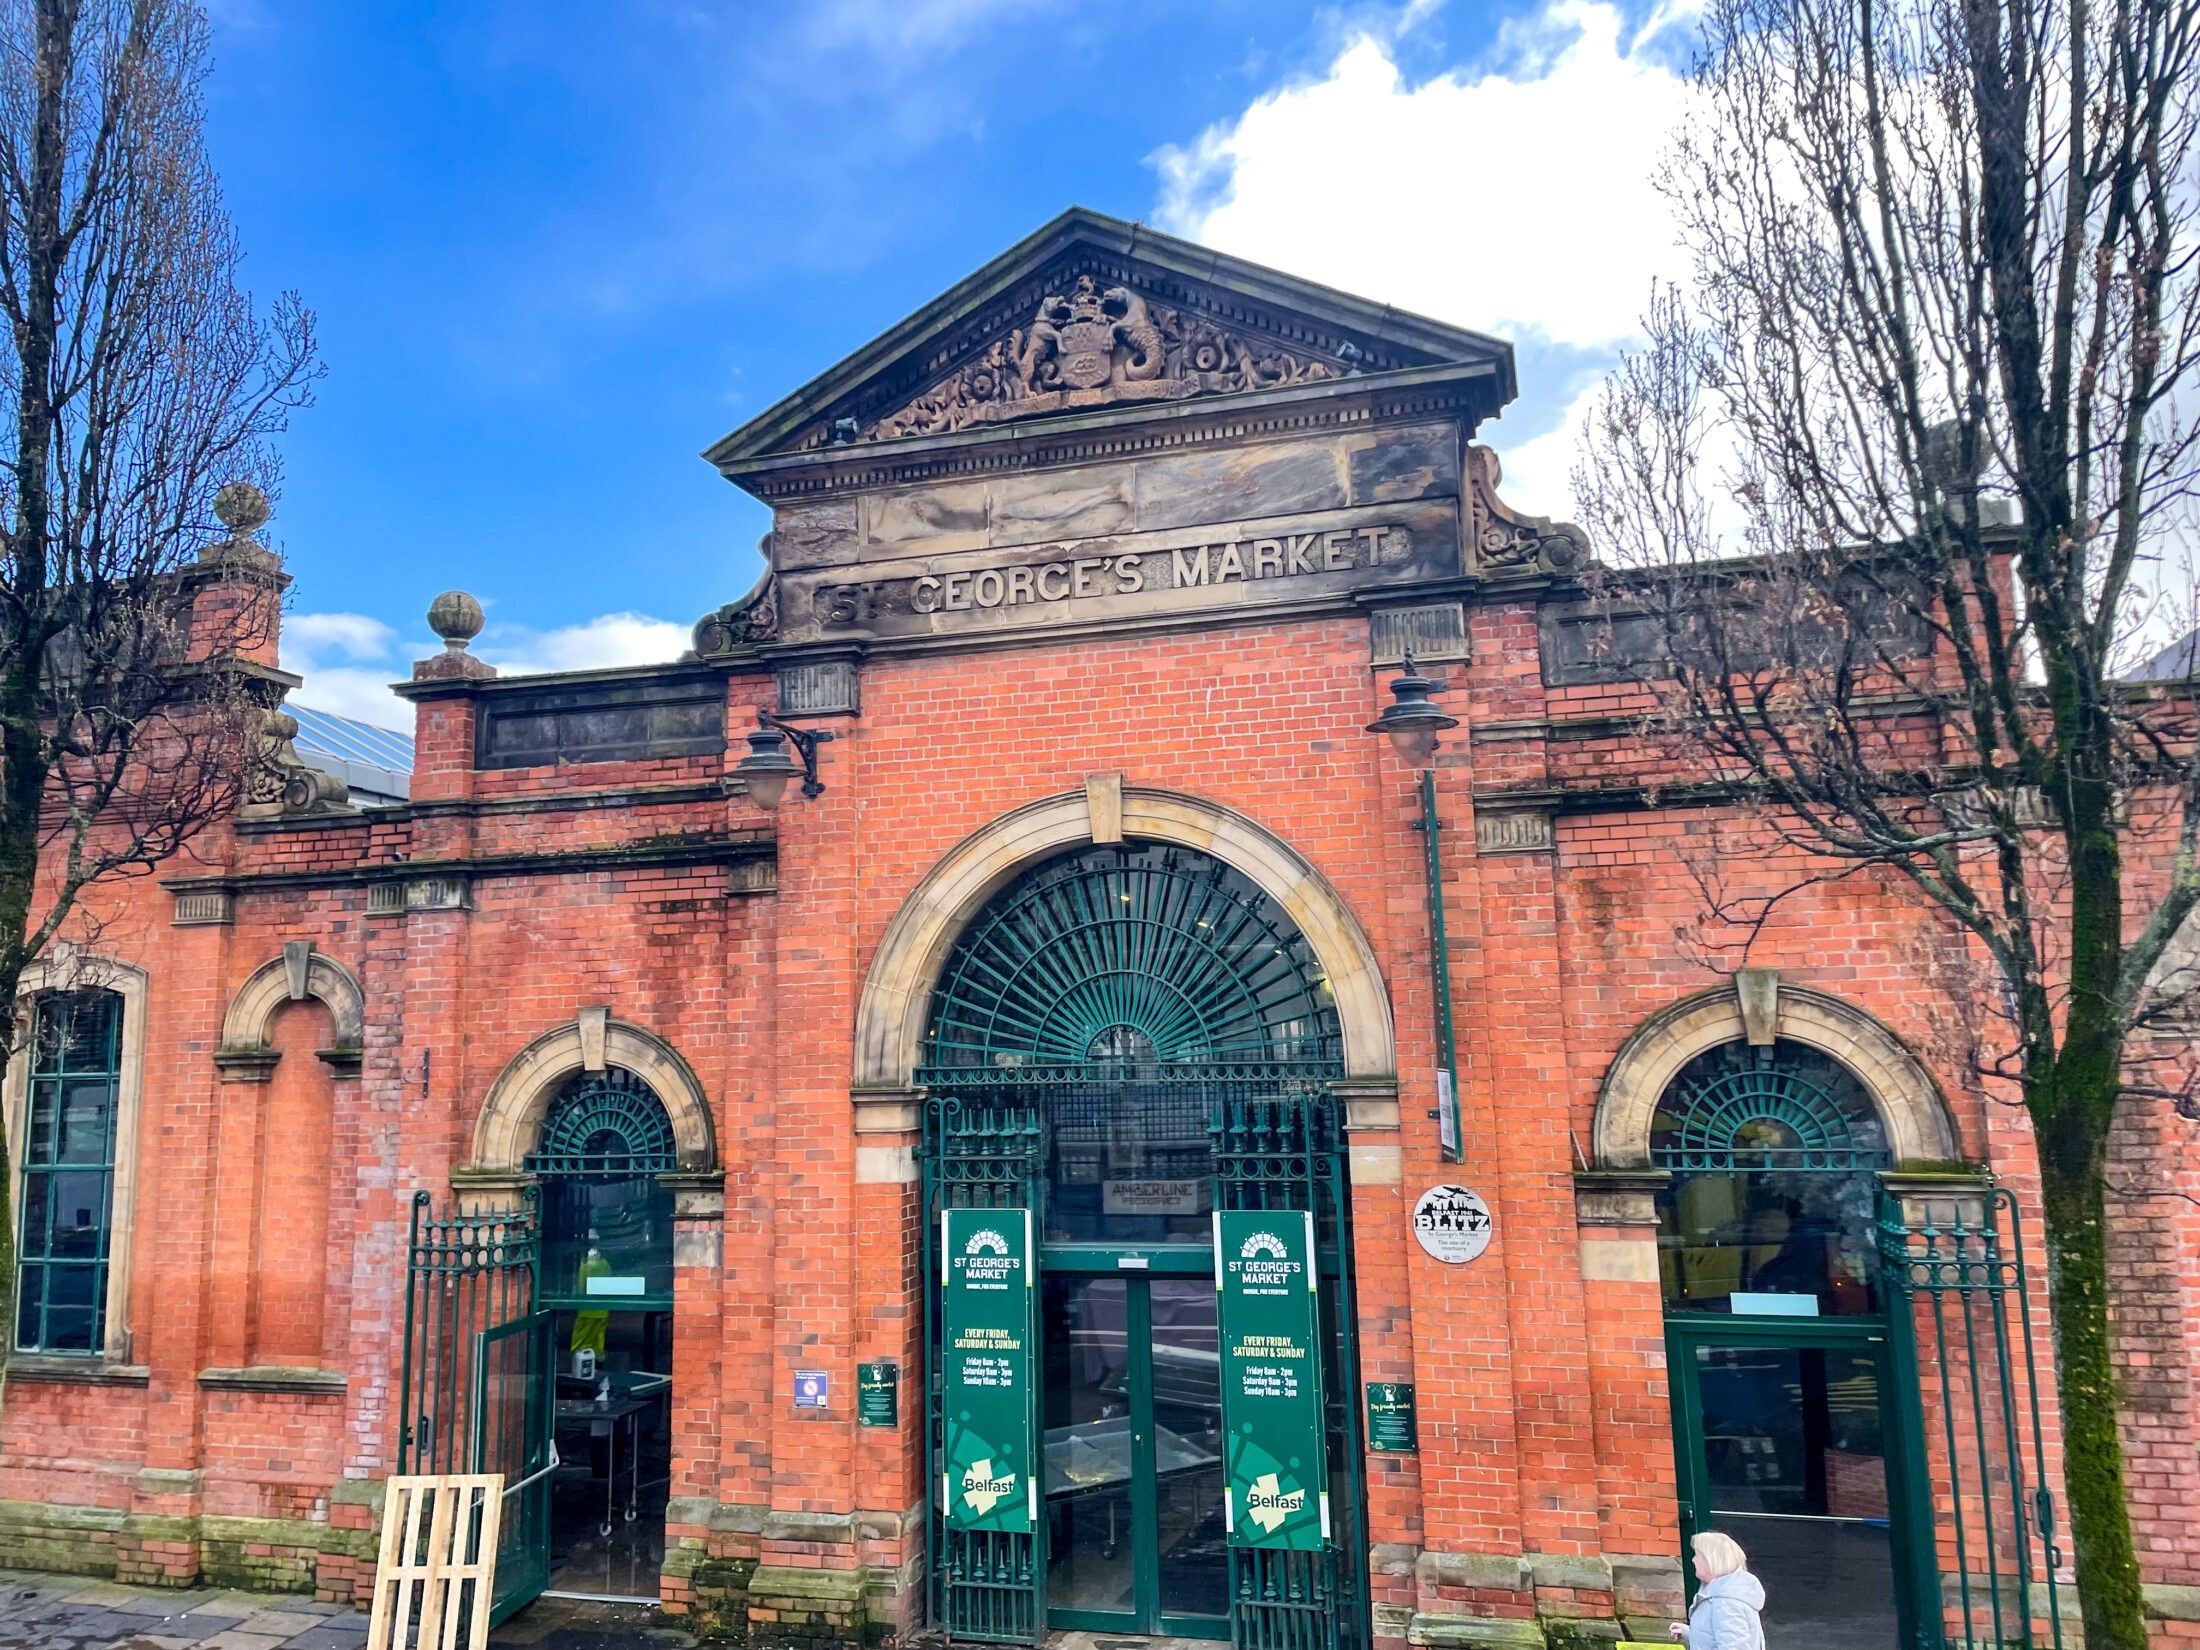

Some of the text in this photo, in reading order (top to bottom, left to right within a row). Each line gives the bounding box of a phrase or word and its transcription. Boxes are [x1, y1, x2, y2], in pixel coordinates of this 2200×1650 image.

[910, 554, 1144, 614] GEORGE'S
[1172, 526, 1390, 589] MARKET
[1416, 1214, 1490, 1231] BLITZ
[954, 1257, 1020, 1268] ST GEORGE'S
[1228, 1261, 1301, 1273] ST GEORGE'S
[965, 1268, 1008, 1279] MARKET
[1242, 1273, 1288, 1284] MARKET
[965, 1328, 1010, 1340] EVERY FRIDAY,
[955, 1338, 1020, 1350] SATURDAY & SUNDAY
[1243, 1335, 1293, 1348] EVERY FRIDAY,
[1233, 1346, 1305, 1358] SATURDAY & SUNDAY
[966, 1357, 982, 1367] Friday
[998, 1358, 1009, 1368] 2pm
[962, 1366, 985, 1376] Saturday
[1001, 1368, 1012, 1377] 3pm
[1246, 1366, 1263, 1376] Friday
[1280, 1367, 1293, 1377] 2pm
[963, 1376, 982, 1387] Sunday
[1000, 1377, 1012, 1387] 3pm
[1242, 1376, 1267, 1386] Saturday
[1285, 1378, 1297, 1387] 3pm
[1244, 1386, 1264, 1397] Sunday
[1284, 1388, 1297, 1398] 3pm
[965, 1478, 1014, 1493] Belfast
[1250, 1493, 1304, 1509] Belfast
